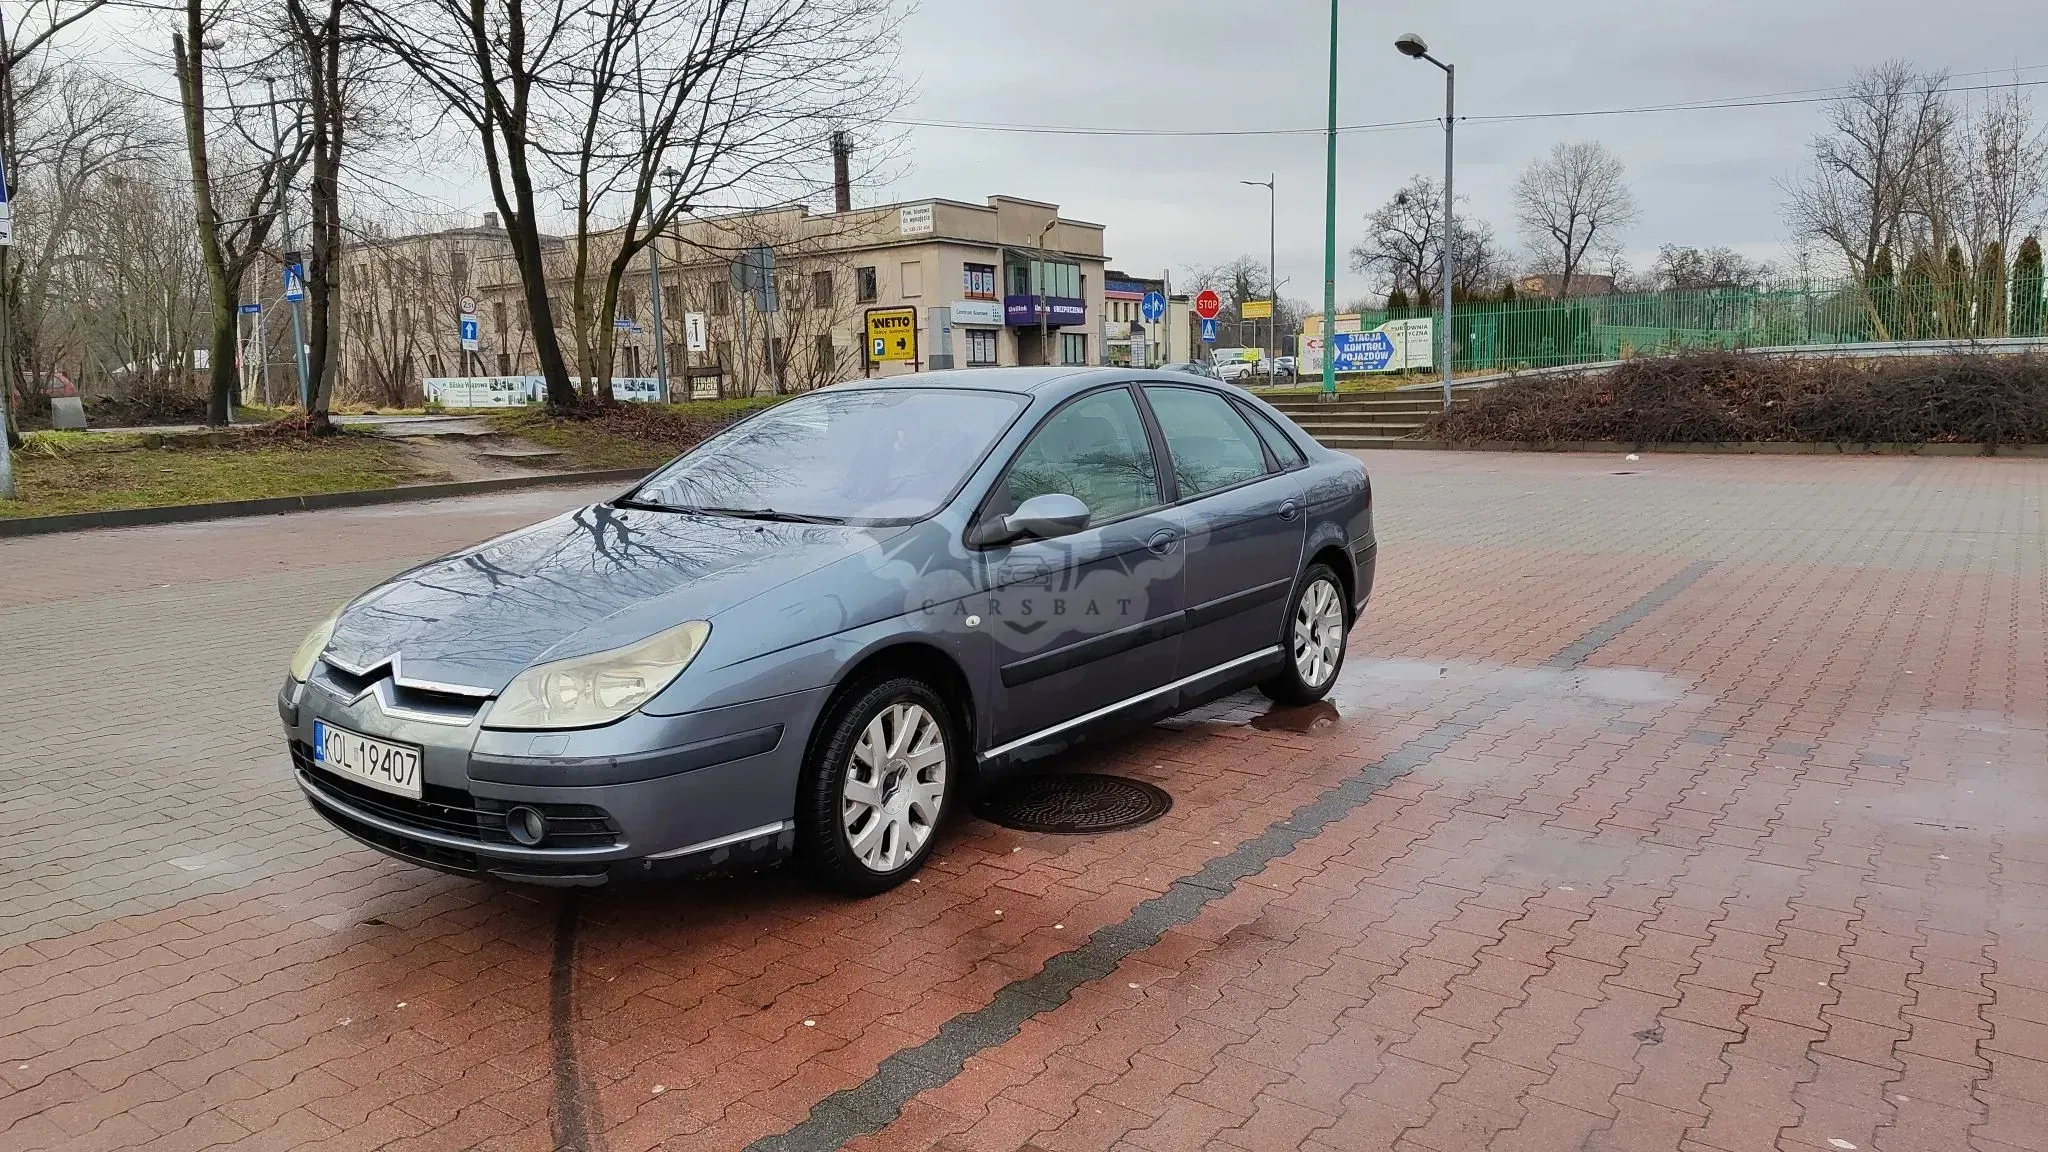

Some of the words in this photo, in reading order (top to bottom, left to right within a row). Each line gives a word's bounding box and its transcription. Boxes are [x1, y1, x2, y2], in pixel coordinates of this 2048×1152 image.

[1198, 299, 1218, 309] STOP
[871, 316, 911, 329] NETTO
[1348, 333, 1382, 343] STACJA
[874, 339, 884, 355] P
[1343, 342, 1387, 352] KONTROLI
[1341, 350, 1389, 361] POJAZDÓW
[693, 376, 718, 384] STOLARZ
[693, 383, 718, 391] TAPICER
[316, 745, 324, 756] PL
[324, 728, 352, 769] KOL
[359, 741, 418, 787] 19407
